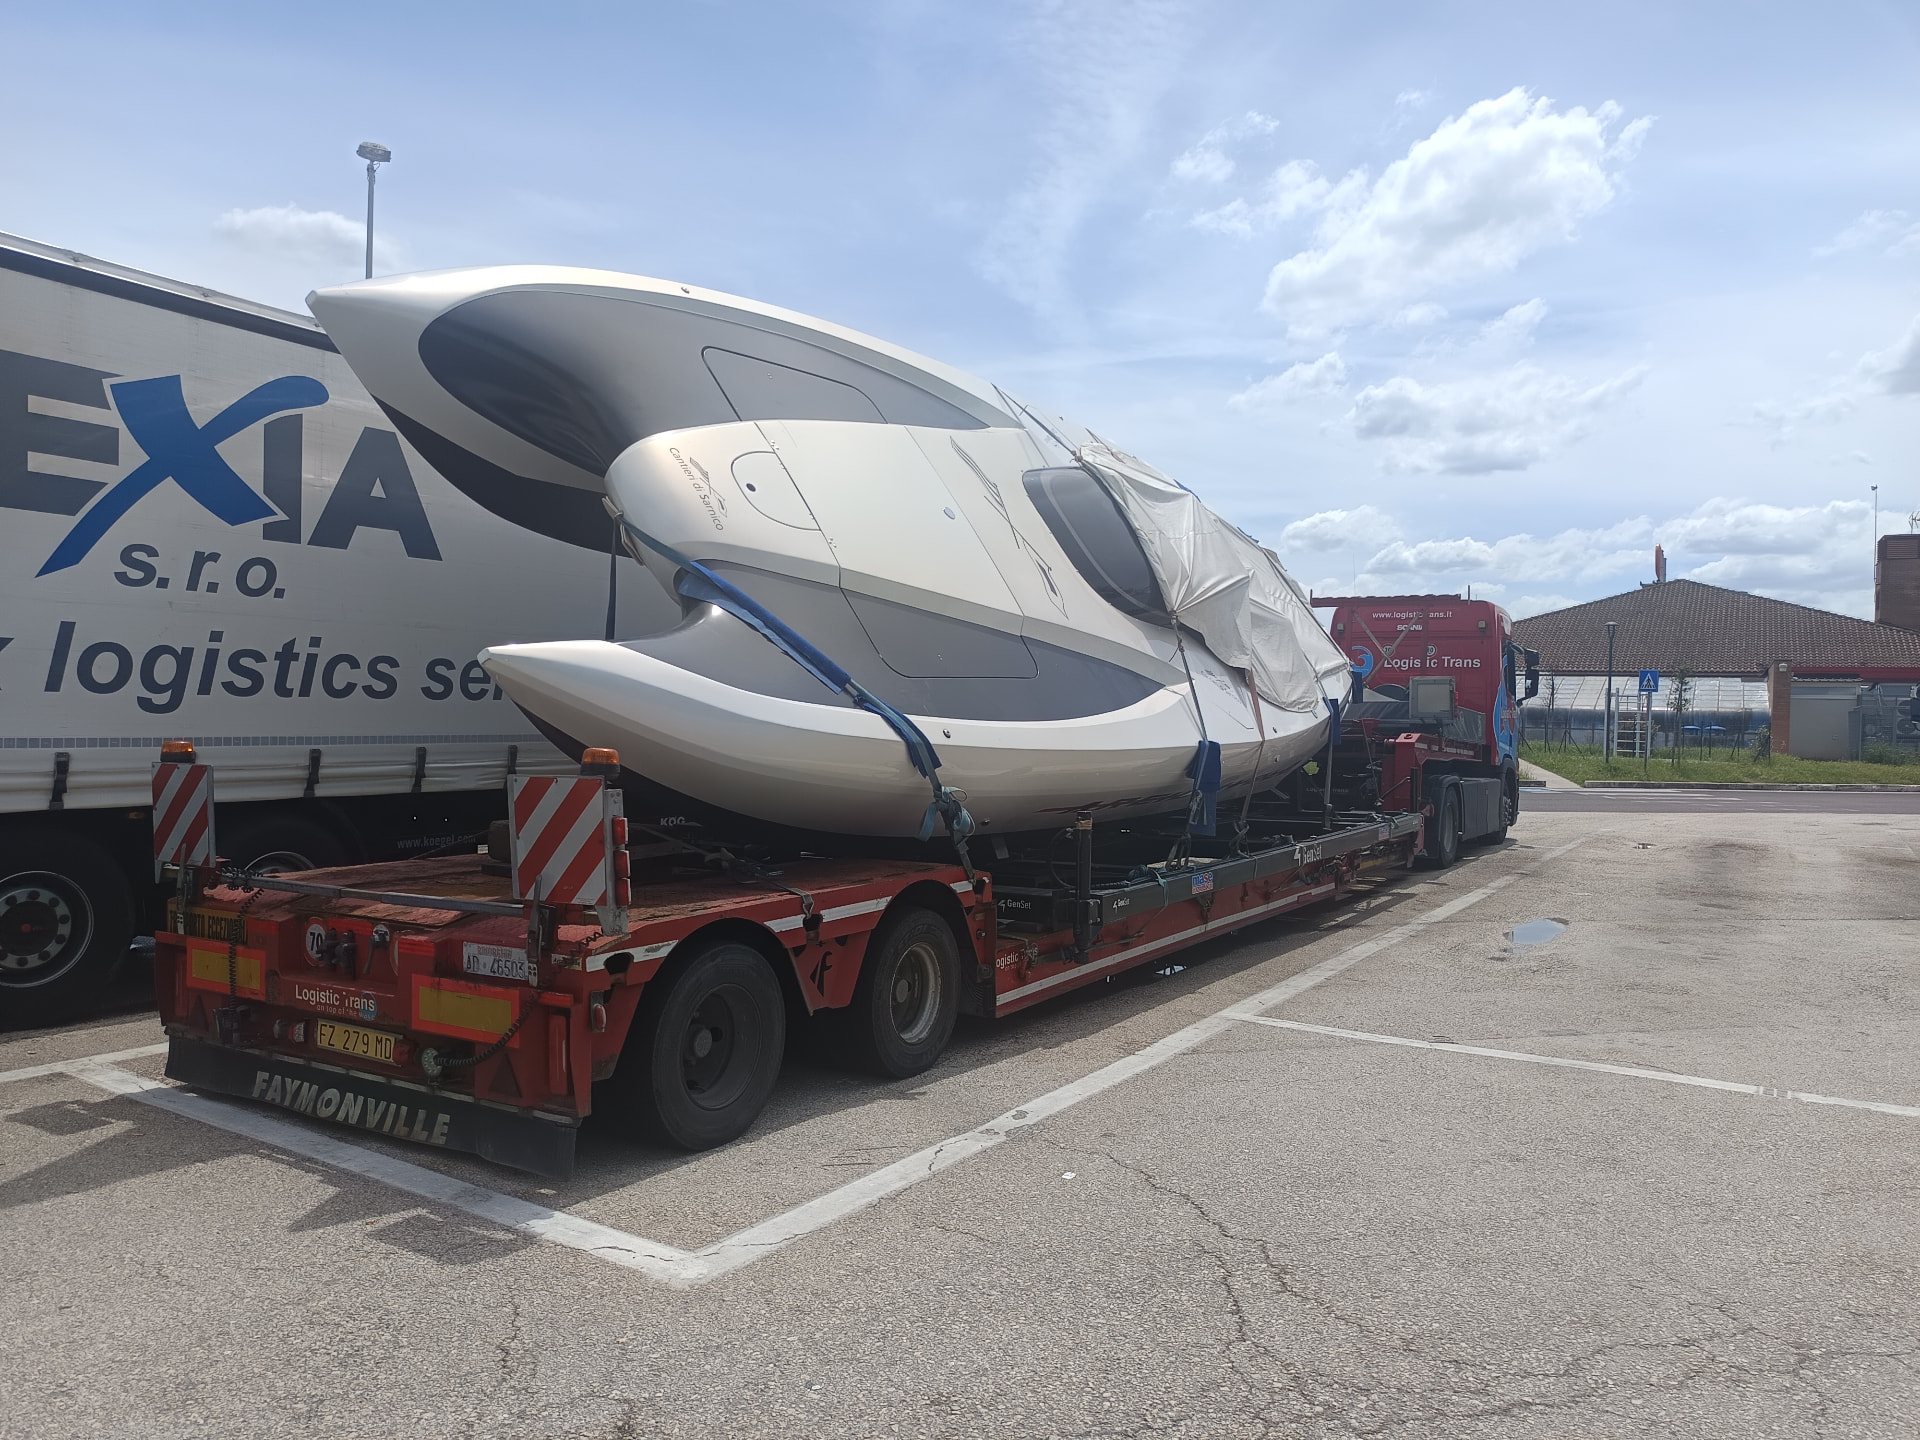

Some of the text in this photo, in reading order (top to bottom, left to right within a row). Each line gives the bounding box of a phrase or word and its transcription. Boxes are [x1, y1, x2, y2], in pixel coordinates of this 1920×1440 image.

[669, 447, 724, 531] Cantieri di Sarnico
[1372, 611, 1452, 620] www.logistcans.it
[44, 620, 400, 715] logistics
[1383, 656, 1481, 671] Logisic Trans
[1007, 899, 1032, 911] GenSet
[996, 951, 1019, 970] ogistic
[295, 984, 340, 1006] Logistic
[320, 1023, 392, 1060] FZ 279 MD
[251, 1070, 450, 1145] FAYMONVILLE
